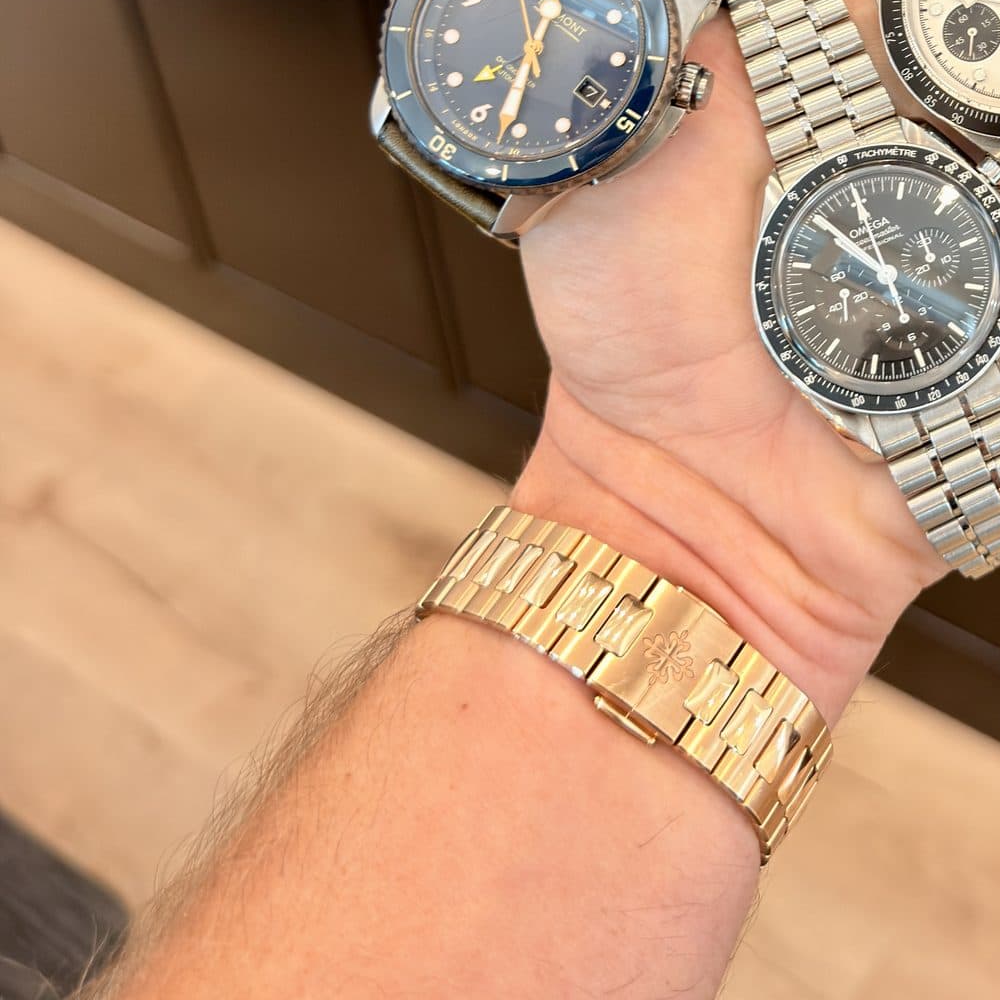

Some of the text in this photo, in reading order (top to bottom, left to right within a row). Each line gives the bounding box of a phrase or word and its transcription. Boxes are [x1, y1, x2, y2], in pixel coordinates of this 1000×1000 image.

[884, 31, 897, 44] 75
[901, 67, 914, 81] 80
[924, 94, 938, 109] 85
[469, 103, 494, 123] 6
[951, 112, 965, 125] 90
[615, 107, 642, 133] 15
[428, 134, 458, 161] 30
[849, 216, 890, 239] OMEGA
[914, 263, 931, 275] 20
[830, 270, 846, 283] 60
[853, 291, 869, 303] 20
[828, 302, 843, 313] 40
[917, 306, 928, 316] 3
[850, 395, 865, 408] 100
[895, 398, 907, 410] 110
